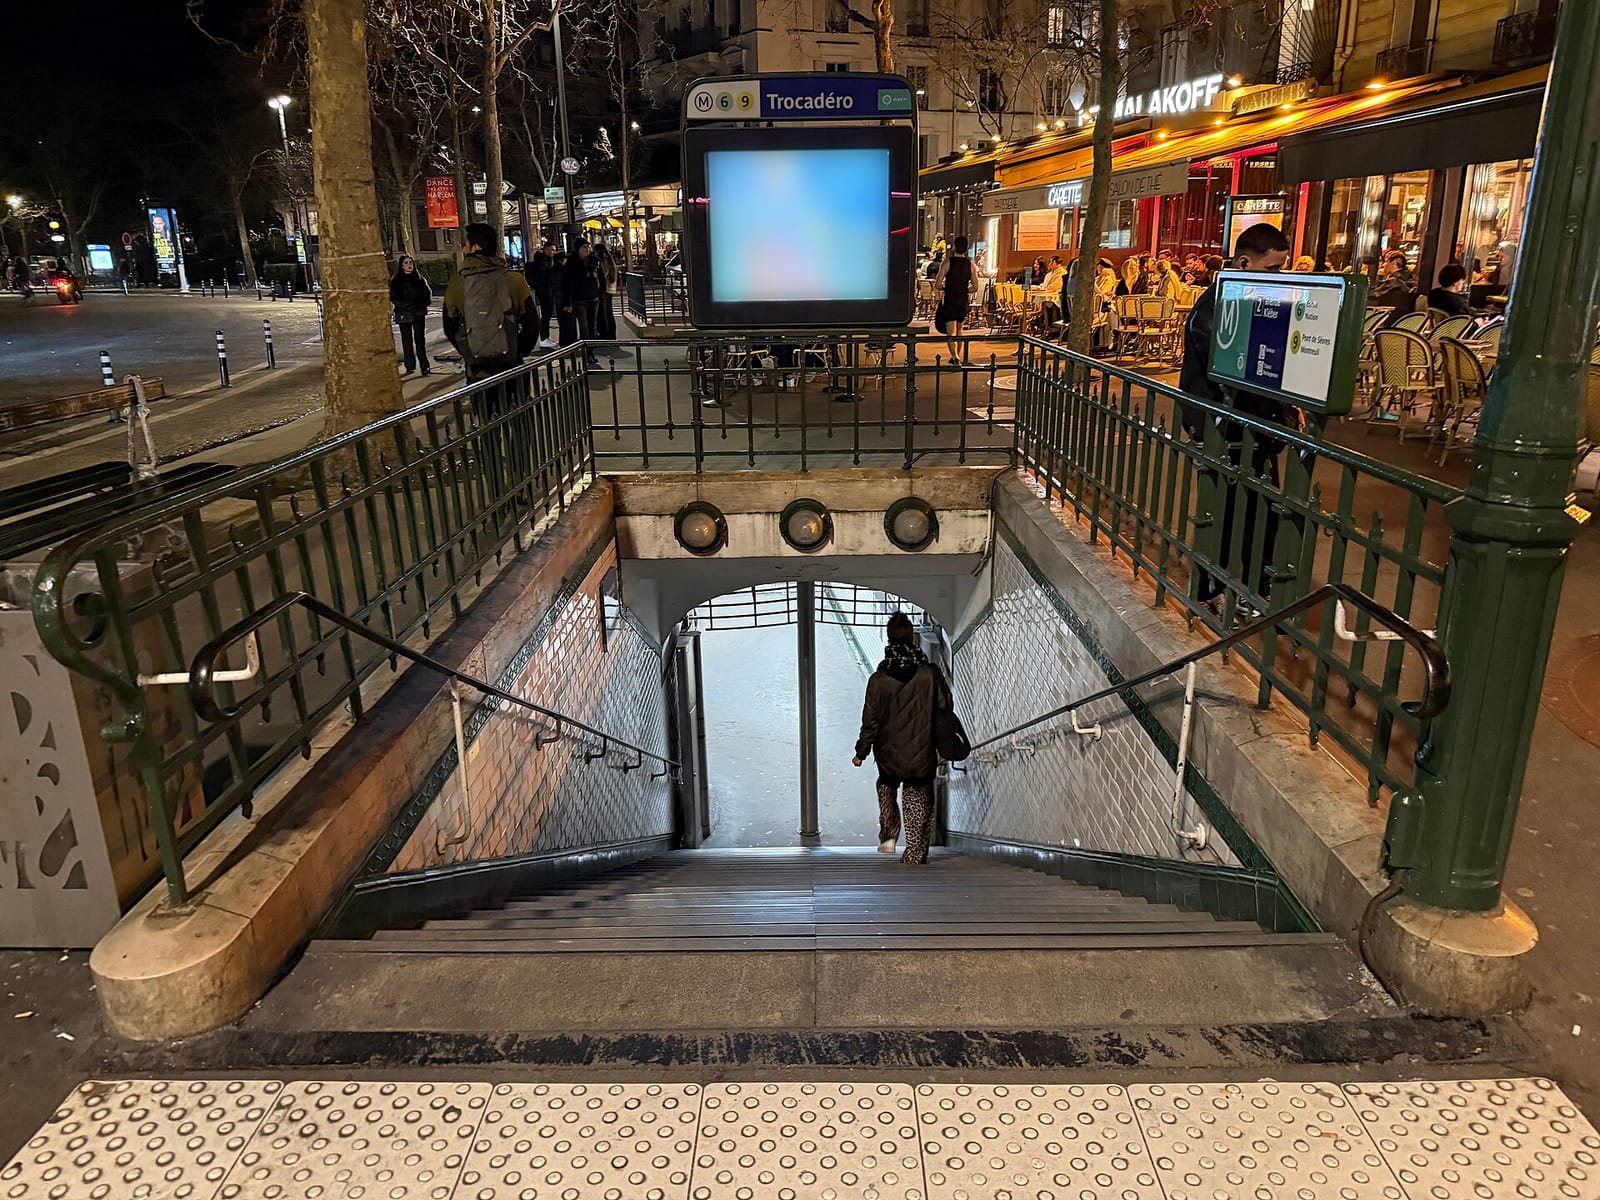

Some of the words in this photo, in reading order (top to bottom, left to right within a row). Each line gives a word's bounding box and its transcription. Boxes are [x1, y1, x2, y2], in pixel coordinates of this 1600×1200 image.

[720, 95, 729, 108] 6
[741, 95, 750, 108] 9
[766, 92, 854, 110] Trocadéro
[1240, 81, 1308, 113] CARETTE
[427, 191, 455, 200] HARLEM
[1048, 186, 1082, 206] CARETTE
[1236, 200, 1282, 212] CARETTE
[1219, 298, 1236, 337] M
